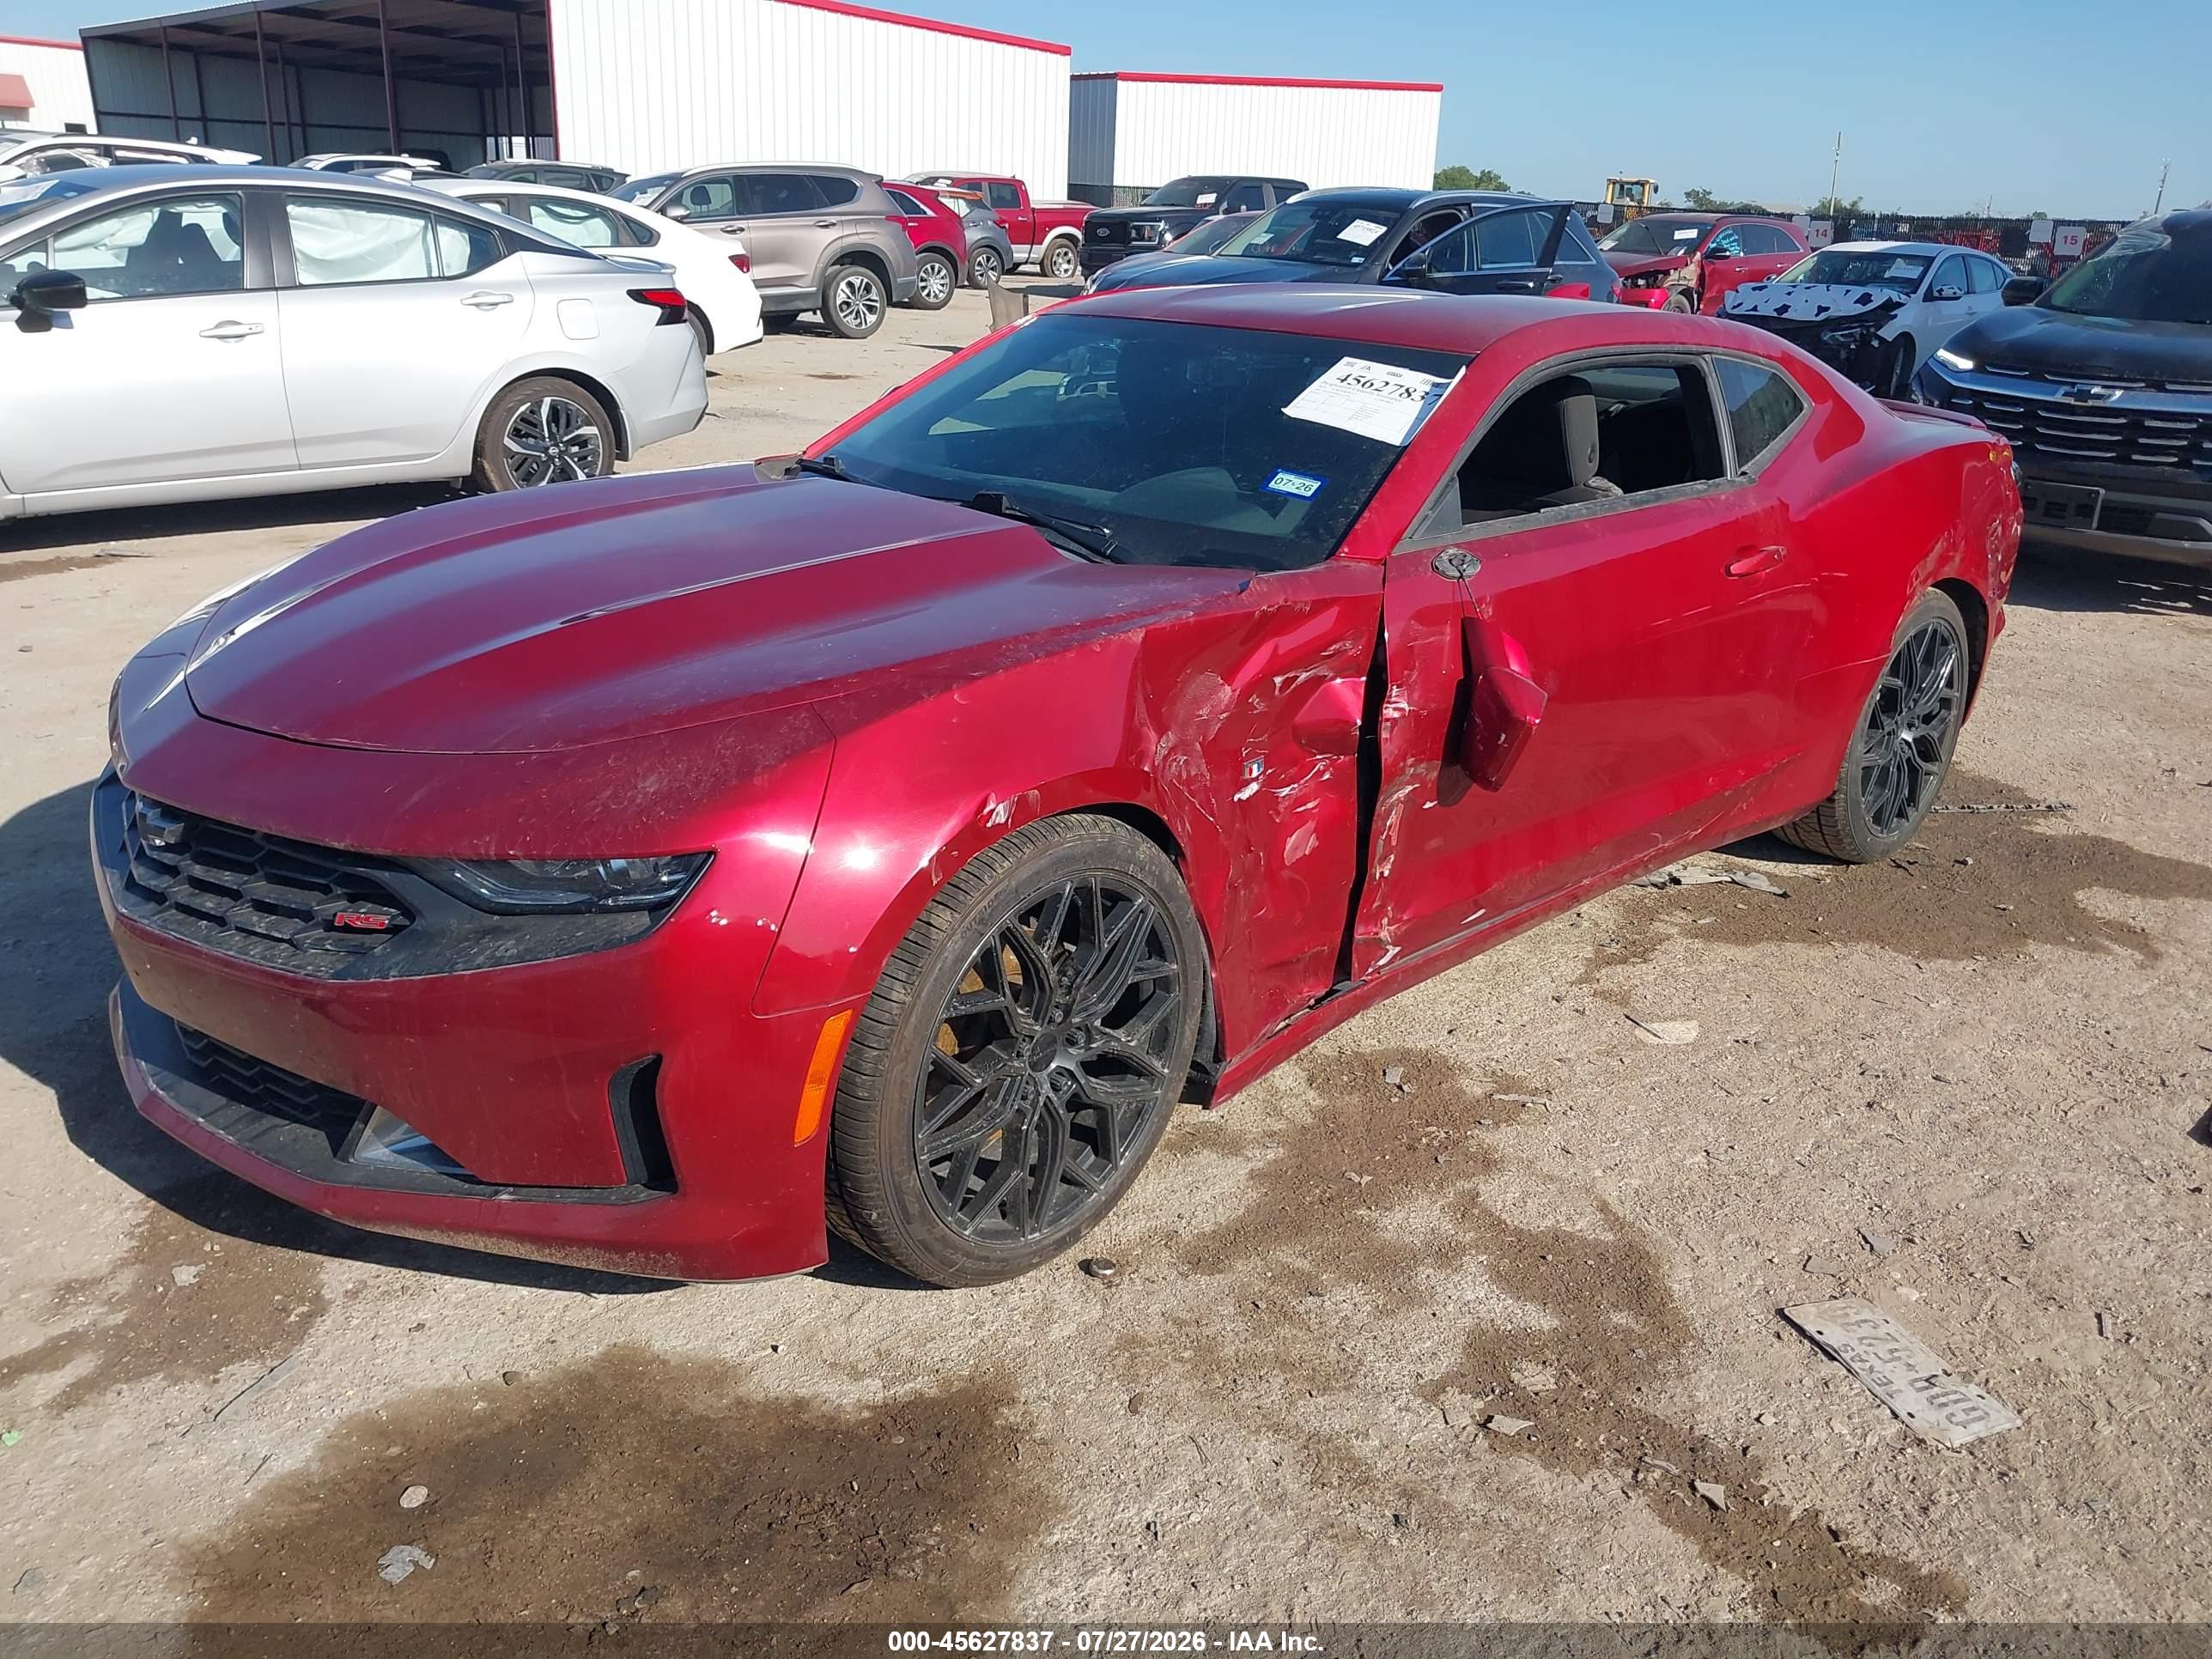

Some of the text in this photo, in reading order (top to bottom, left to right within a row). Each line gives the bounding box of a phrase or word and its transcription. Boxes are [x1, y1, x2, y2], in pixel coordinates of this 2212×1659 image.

[1814, 228, 1827, 238] 14
[2063, 235, 2078, 245] 15
[1336, 373, 1443, 406] 45627837
[1274, 477, 1314, 492] 07 26
[334, 912, 391, 929] RS
[1840, 1342, 1904, 1399] TEXAS
